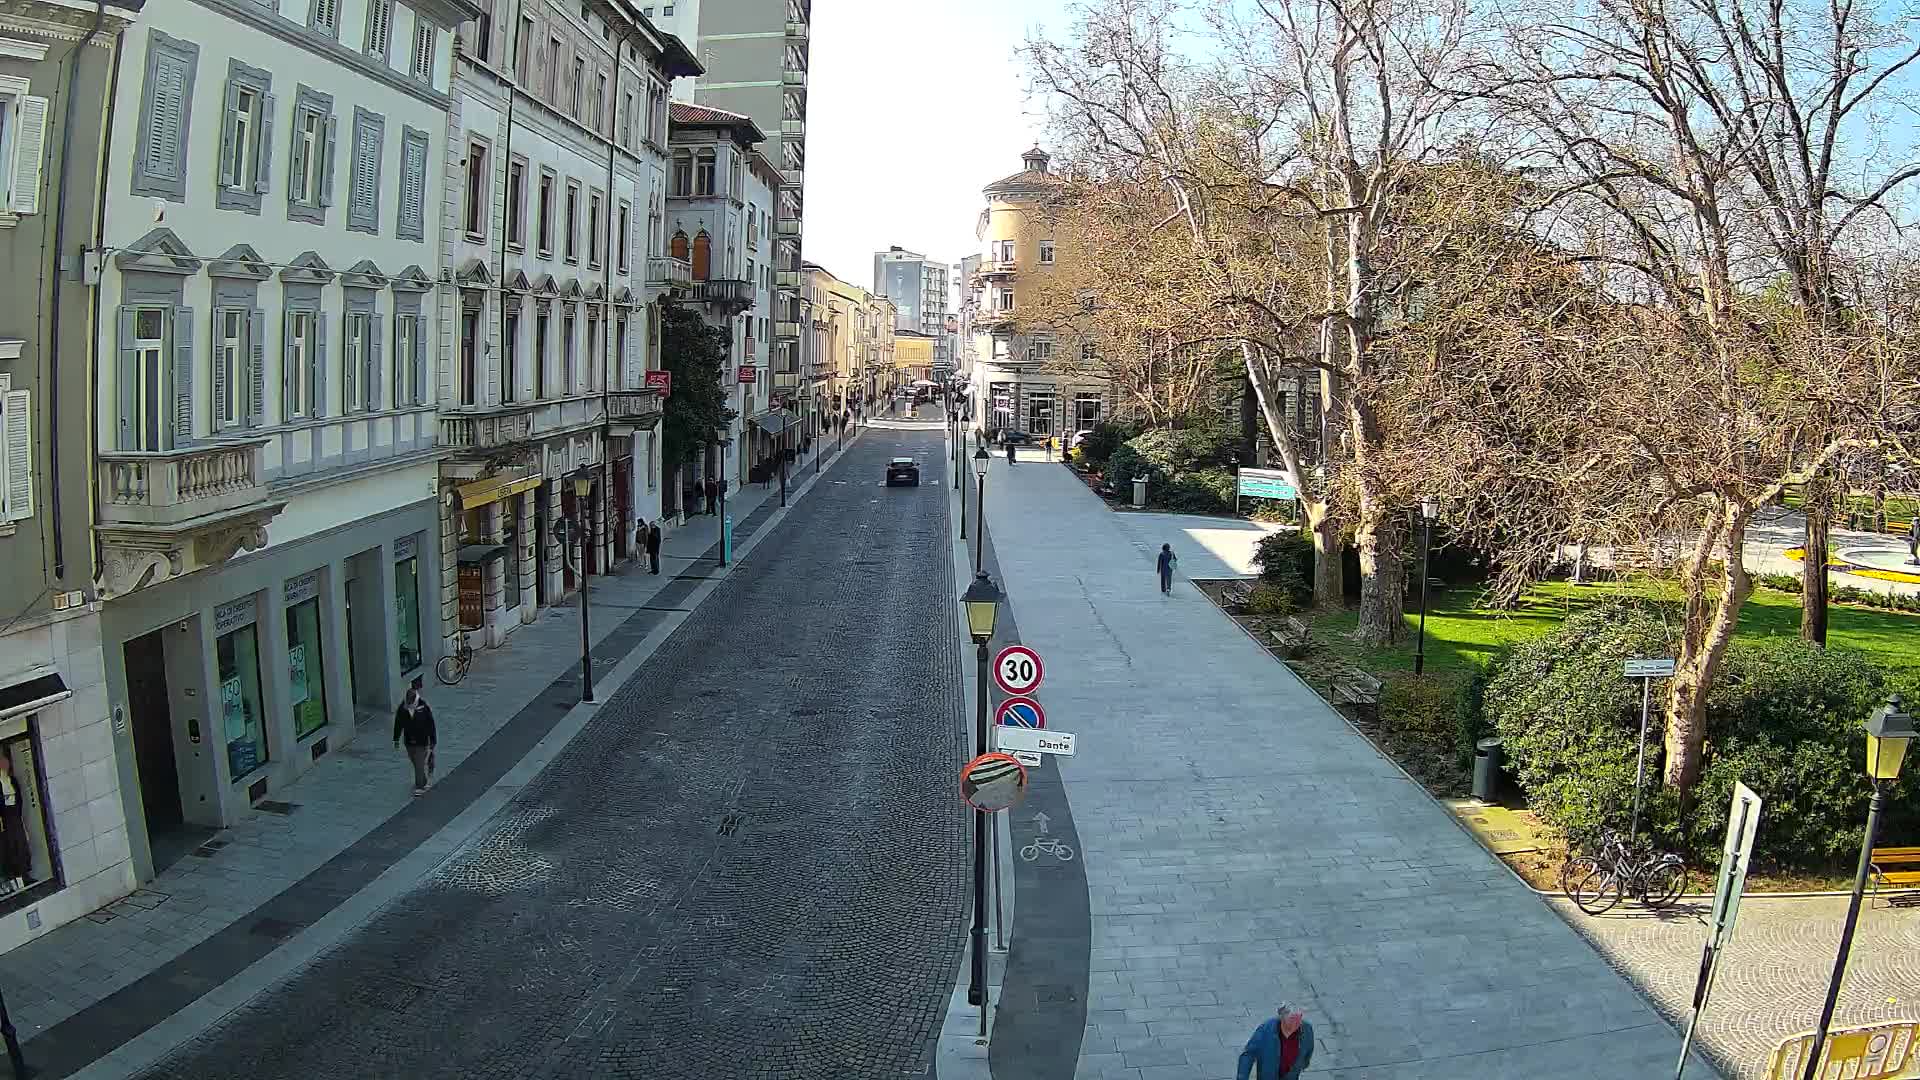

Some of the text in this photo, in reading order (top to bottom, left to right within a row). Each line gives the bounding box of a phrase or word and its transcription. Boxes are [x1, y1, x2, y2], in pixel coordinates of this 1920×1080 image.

[1005, 659, 1033, 682] 30
[223, 679, 241, 700] 130
[1038, 739, 1071, 751] Dante
